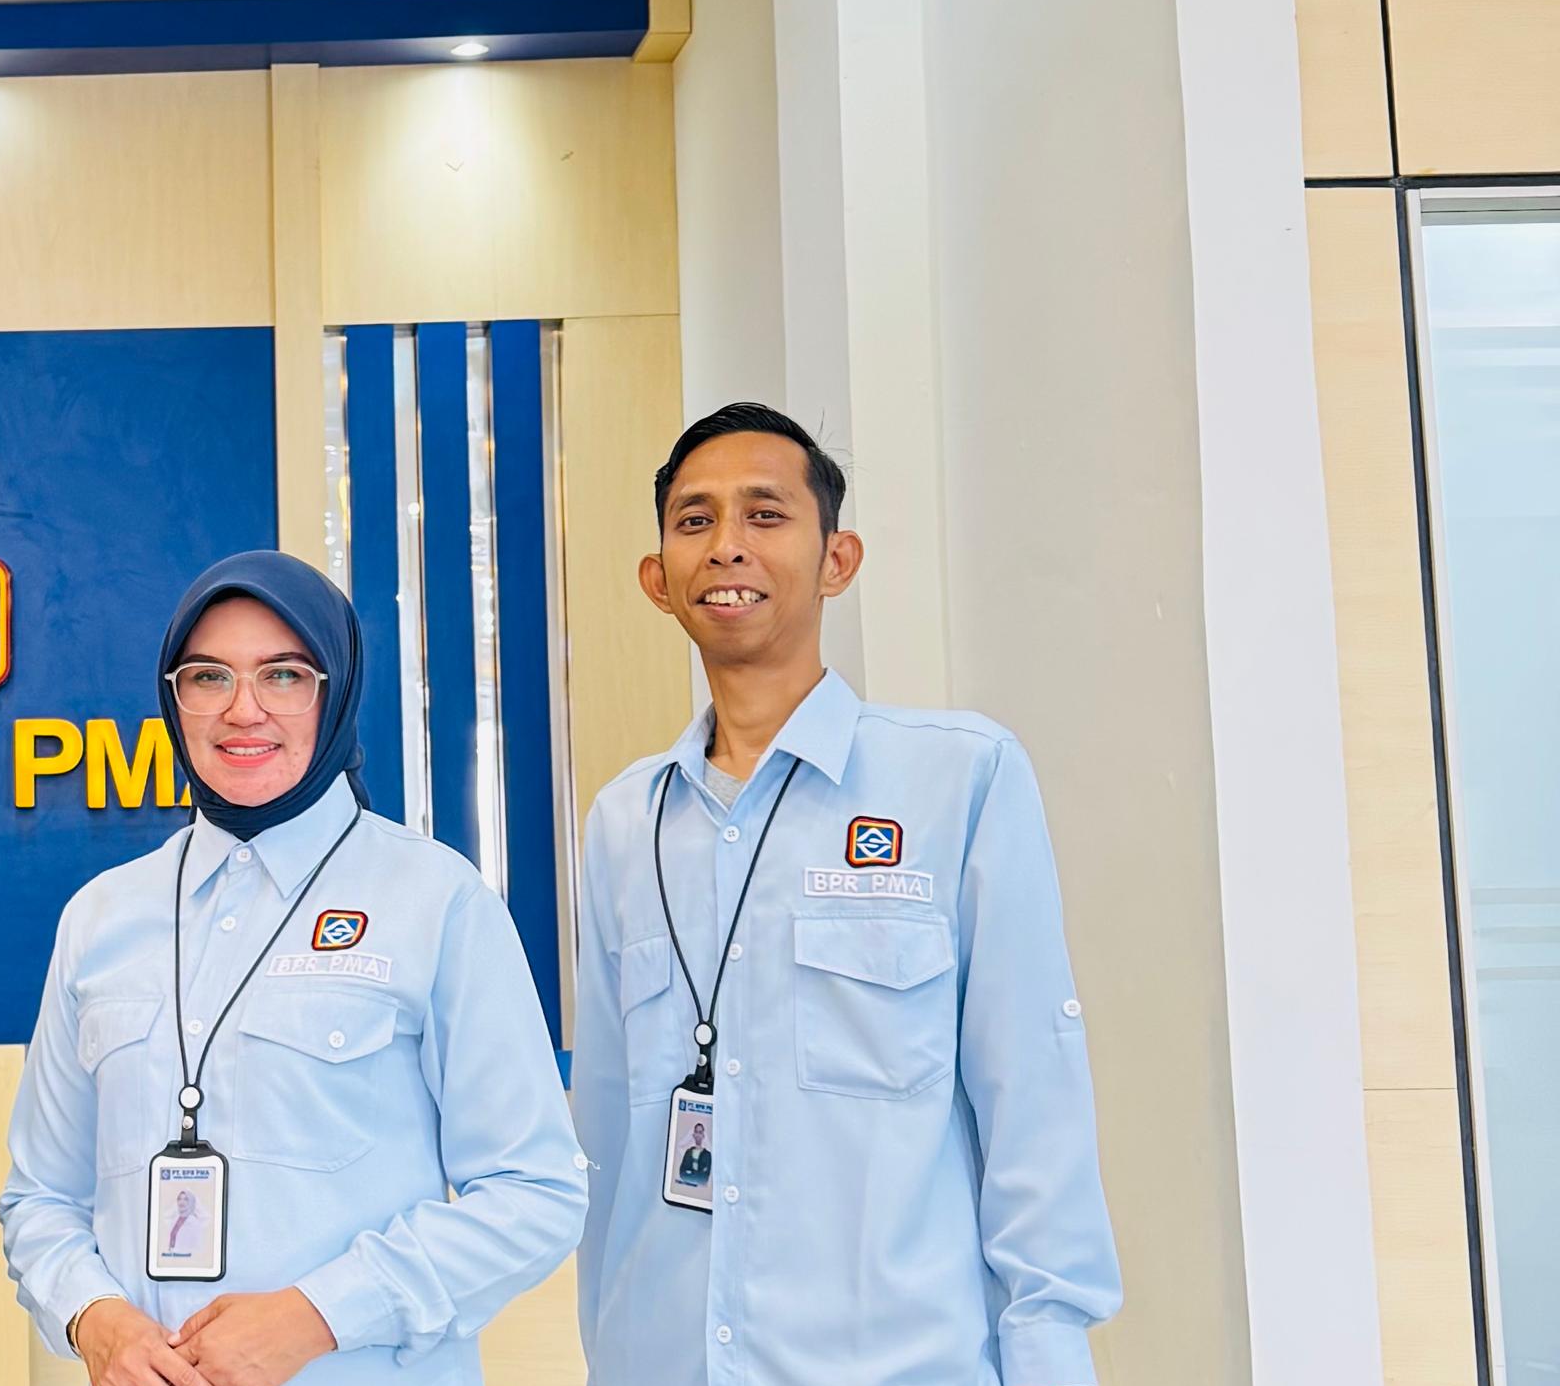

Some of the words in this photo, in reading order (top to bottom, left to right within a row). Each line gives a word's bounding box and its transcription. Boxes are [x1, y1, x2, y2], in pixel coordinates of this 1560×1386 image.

[14, 718, 191, 809] PM
[813, 872, 858, 892] BPR
[871, 874, 924, 896] PMA
[277, 957, 318, 973] BPR
[329, 955, 380, 977] PMA
